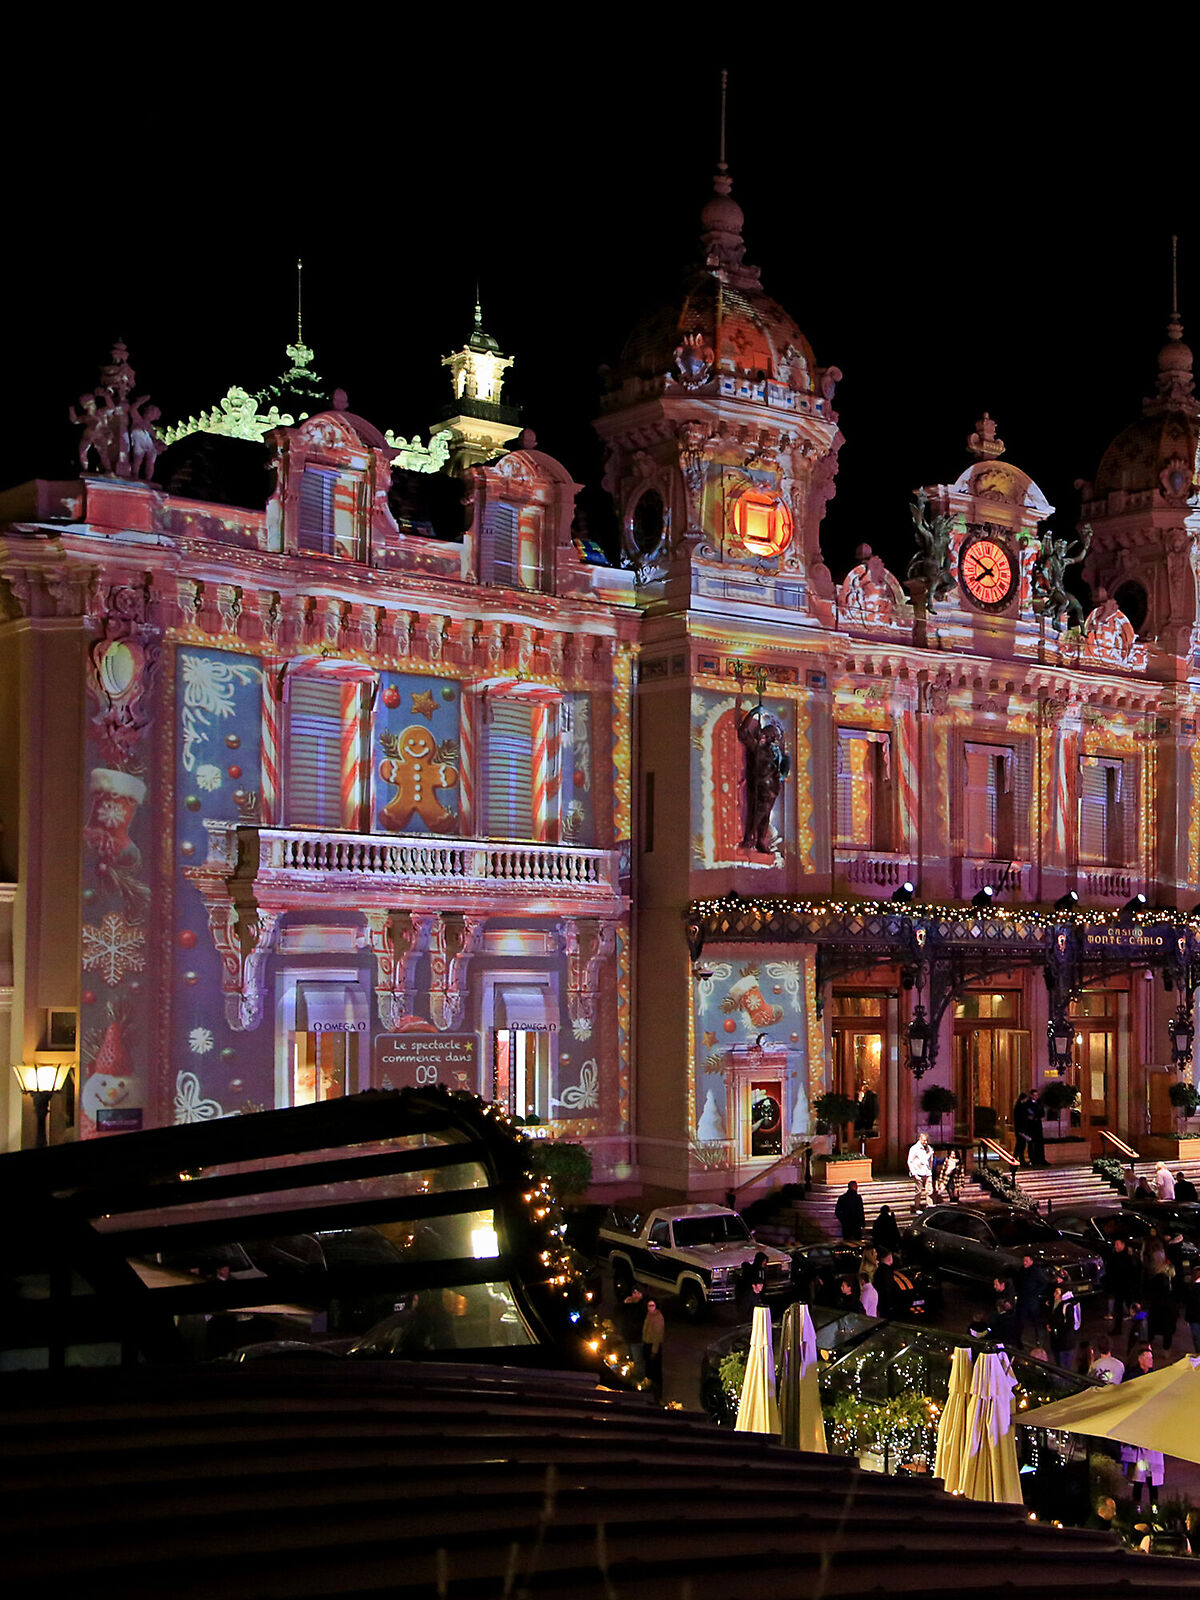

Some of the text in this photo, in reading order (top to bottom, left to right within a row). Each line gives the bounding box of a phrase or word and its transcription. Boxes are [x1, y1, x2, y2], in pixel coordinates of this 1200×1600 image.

[1107, 928, 1143, 936] CASINO
[324, 1023, 356, 1031] OMEGA
[521, 1022, 548, 1031] OMEGA
[393, 1039, 461, 1055] Le spectacle
[382, 1052, 472, 1063] commence dans
[416, 1065, 438, 1084] 09
